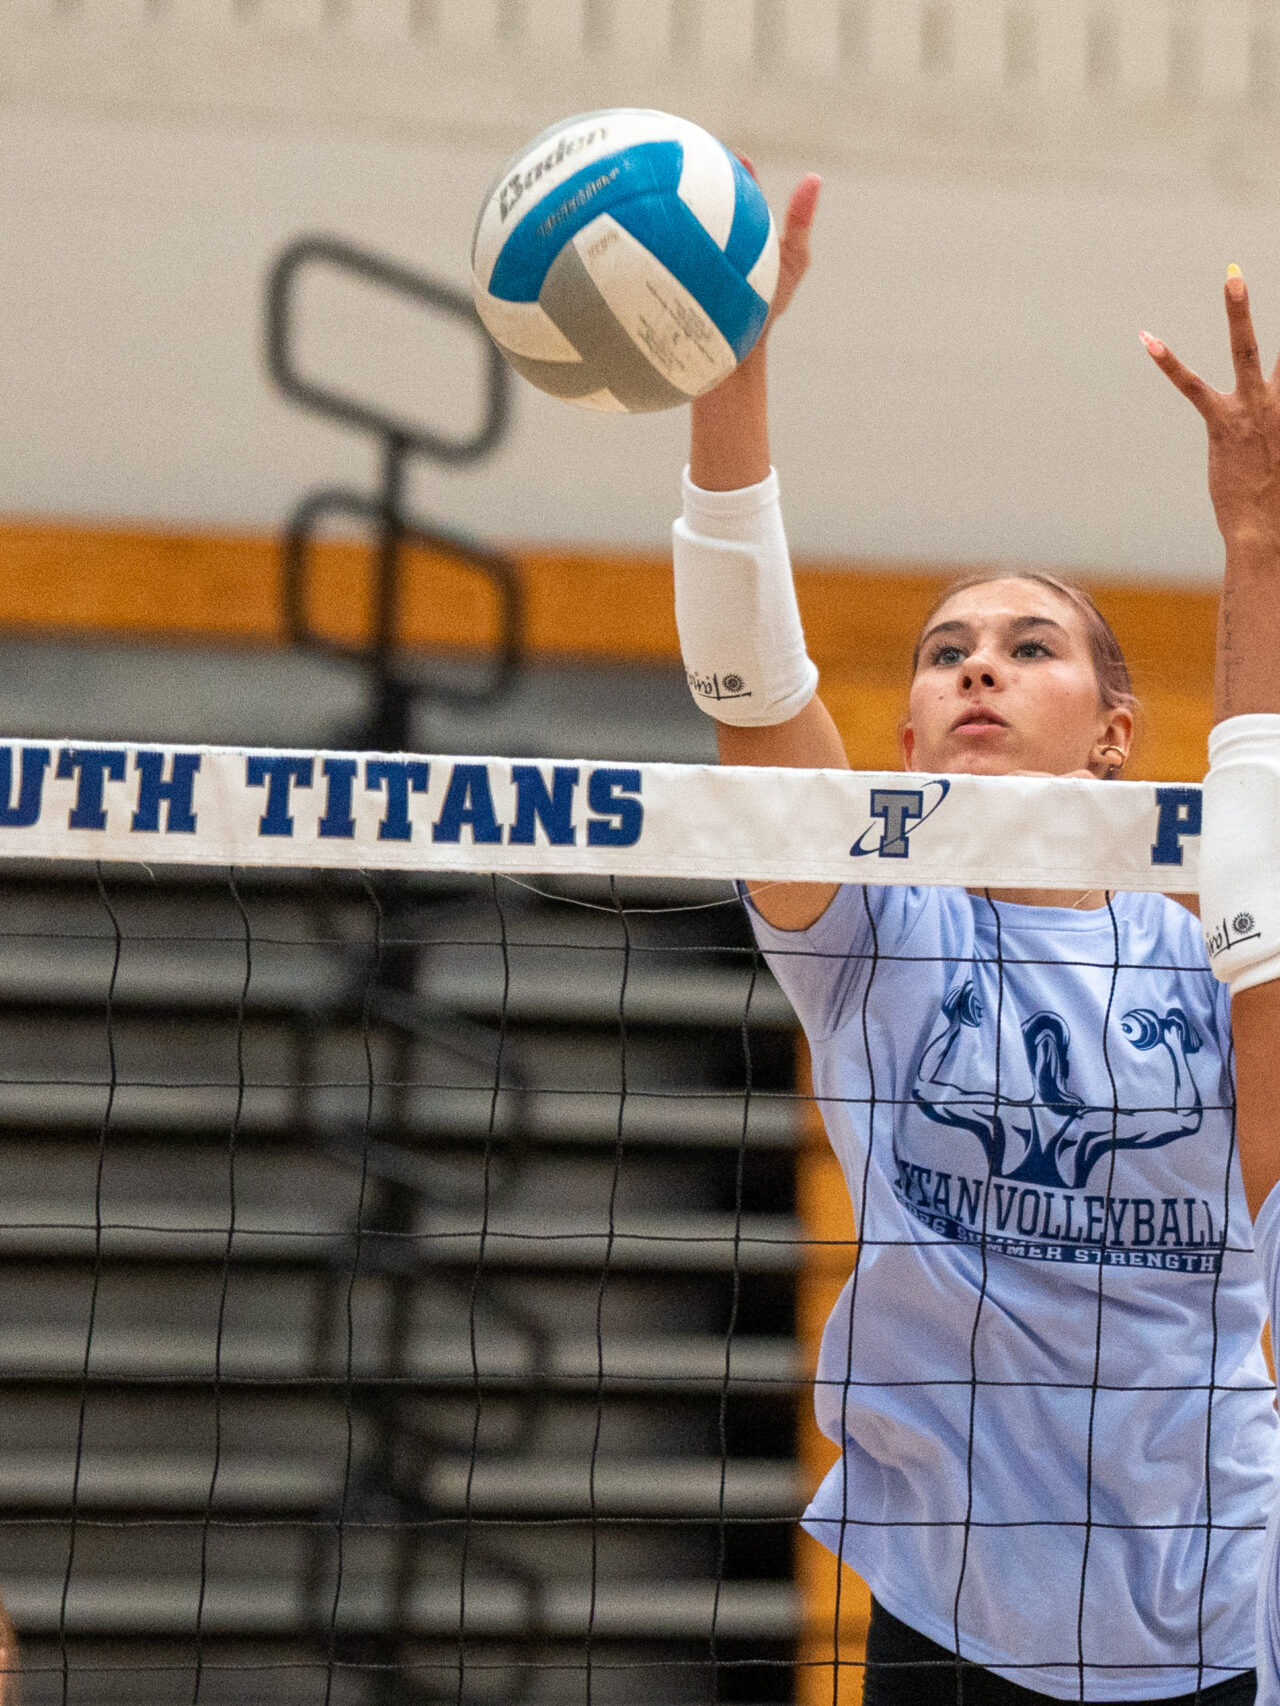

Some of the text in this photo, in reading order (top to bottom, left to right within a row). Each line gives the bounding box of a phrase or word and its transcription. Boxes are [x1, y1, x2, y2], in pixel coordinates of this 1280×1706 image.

[499, 127, 609, 223] Baden
[245, 755, 646, 847] TITANS
[993, 1183, 1224, 1248] VOLLEYBALL
[1074, 1249, 1216, 1272] STRENGTH
